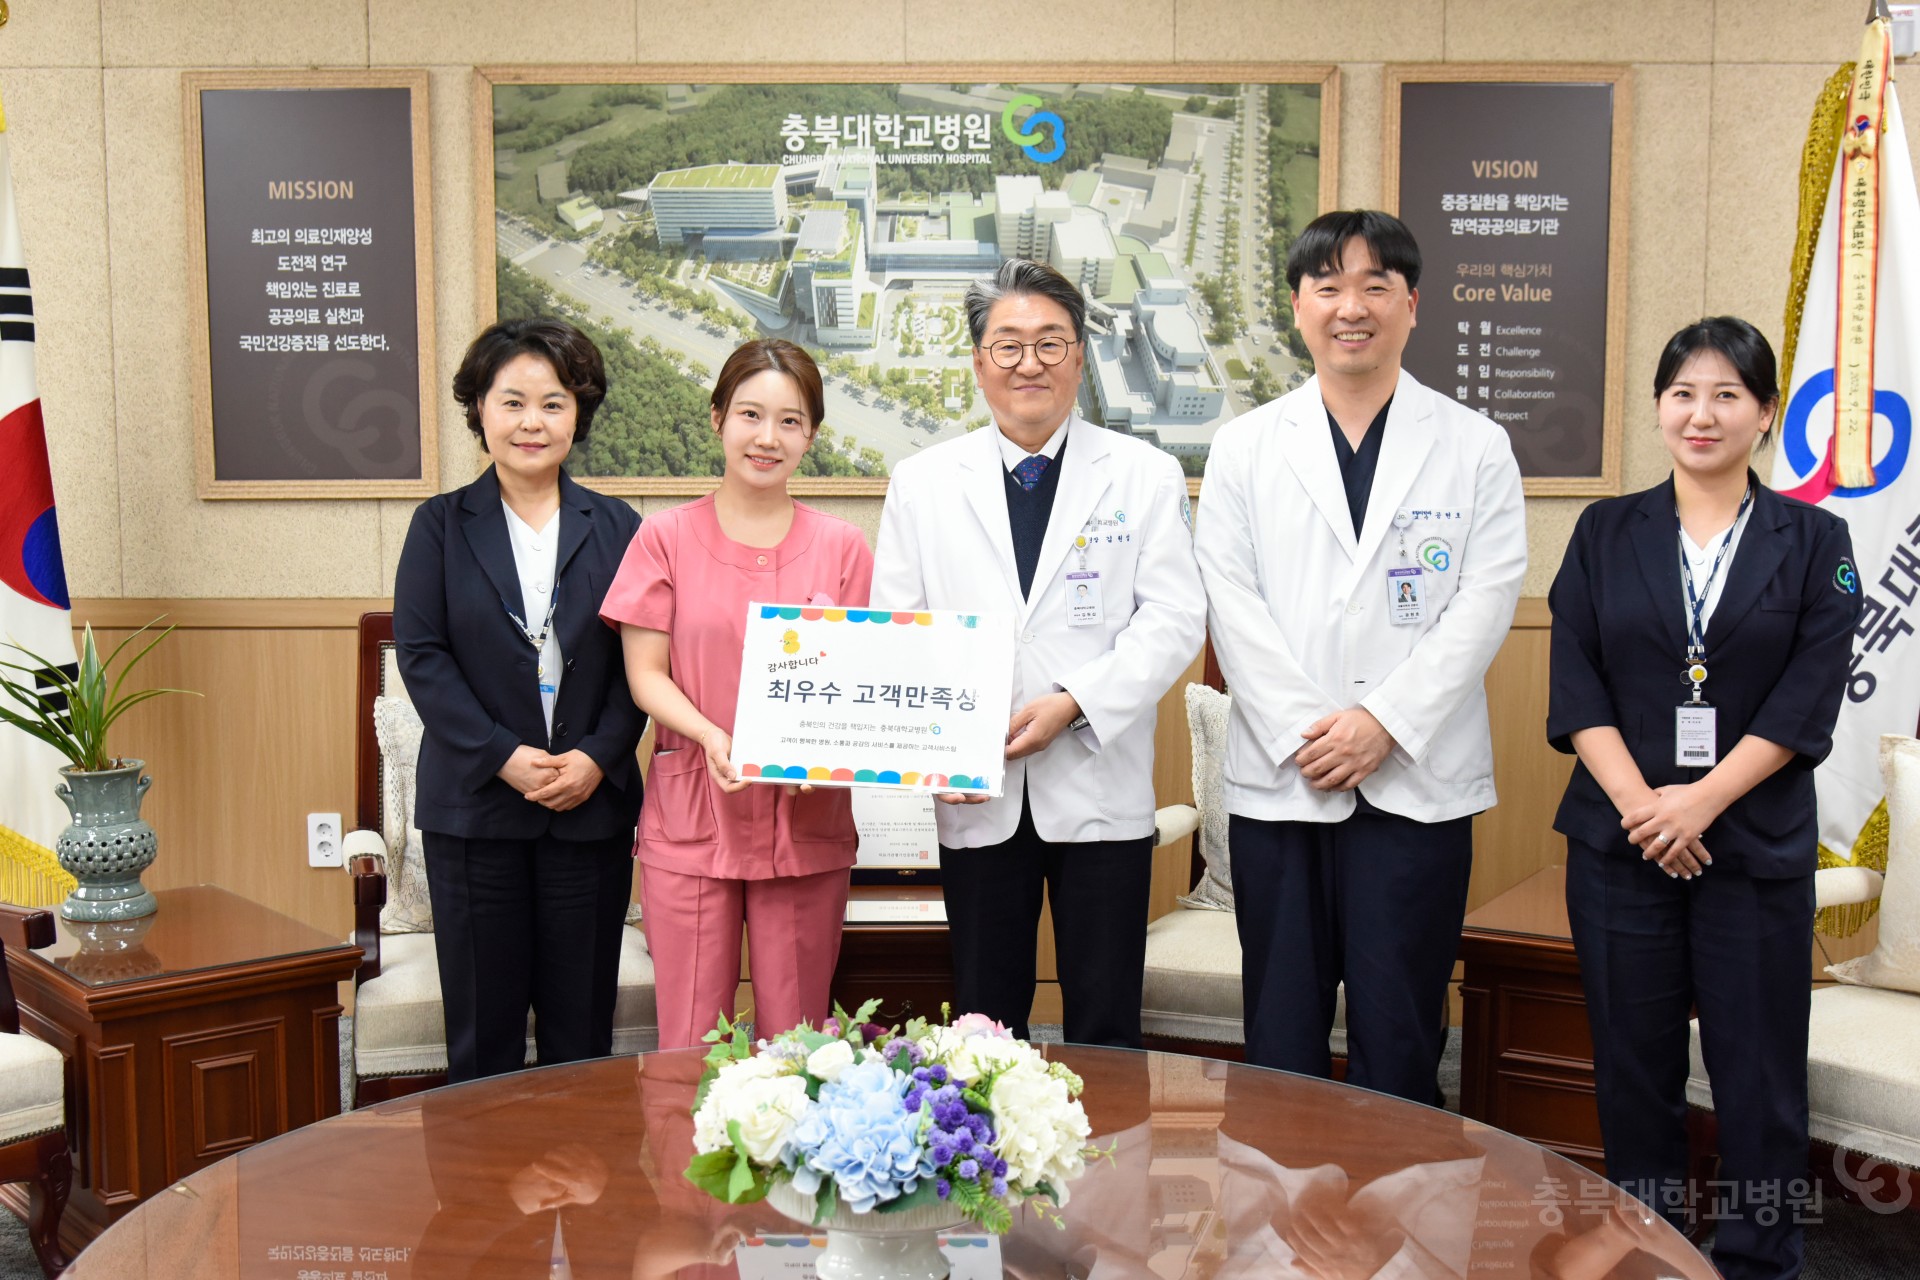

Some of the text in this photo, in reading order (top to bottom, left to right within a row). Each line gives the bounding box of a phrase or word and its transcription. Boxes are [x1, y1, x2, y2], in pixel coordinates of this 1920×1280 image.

[780, 113, 992, 152] 충북대학교병원
[888, 154, 943, 165] UNIVERSITY
[946, 154, 991, 165] HOSPITAL
[1472, 160, 1538, 178] VISION
[268, 180, 354, 200] MISSION
[1441, 194, 1569, 212] 중증질환을 책임지는
[1450, 218, 1560, 235] 권역공공의료기관
[251, 227, 372, 246] 최고의 의료인재양성
[277, 254, 348, 272] 도전적 연구
[1456, 263, 1552, 278] 우리의 핵심가치
[266, 281, 361, 299] 책임있는 진료로
[1452, 284, 1552, 302] Core Value
[268, 308, 364, 325] 공공의료 실천과
[1496, 325, 1542, 336] Excellence
[239, 334, 390, 352] 국민건강증진을 선도한다.
[1495, 347, 1541, 358] Challenge
[1495, 368, 1555, 380] Responsibility
[1494, 389, 1555, 400] Collaboration
[1494, 411, 1528, 422] Respect
[767, 656, 819, 673] 감사합니다
[767, 679, 977, 711] 최우수 고객만족상
[799, 720, 928, 734] 충북인의 건강을 책임지는 충북대학교병원
[871, 741, 895, 749] 서비스를
